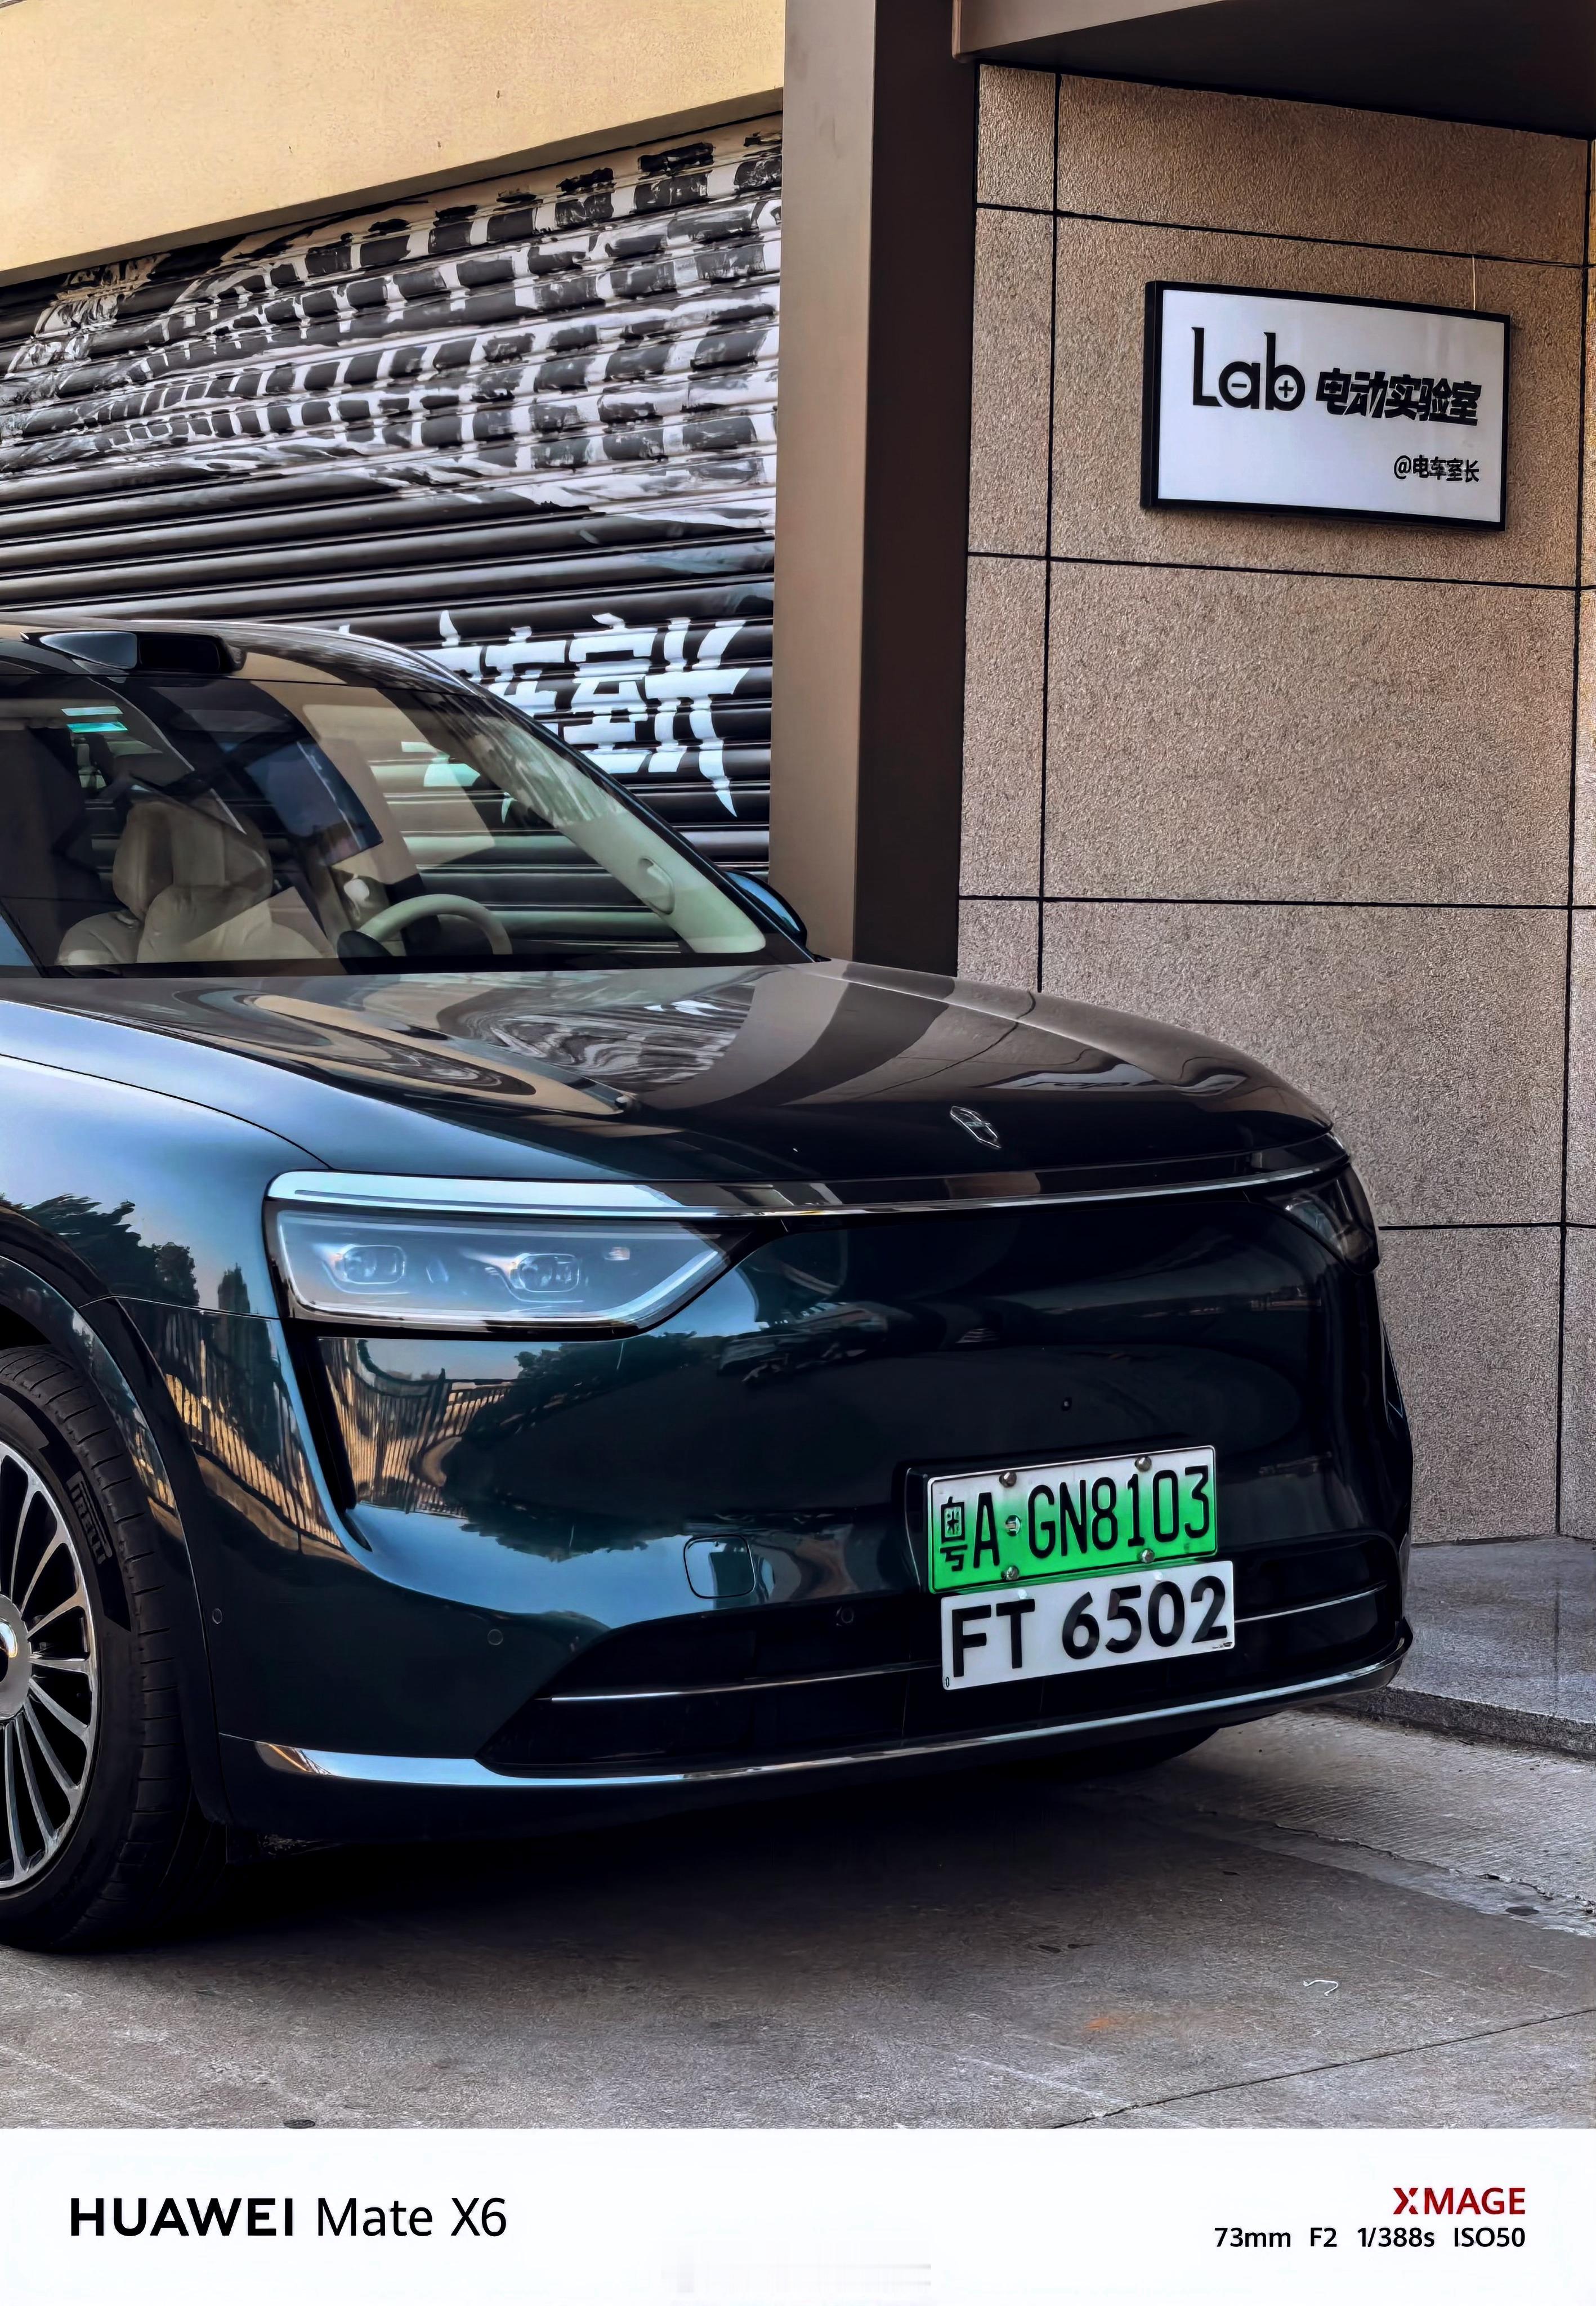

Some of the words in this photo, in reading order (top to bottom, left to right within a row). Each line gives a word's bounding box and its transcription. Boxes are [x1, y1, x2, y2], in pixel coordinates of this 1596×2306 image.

[1191, 327, 1306, 411] Lab
[1315, 367, 1482, 426] 电动实验室
[1393, 454, 1480, 483] @电车室长
[66, 1470, 113, 1565] PIRELLI
[951, 1598, 1036, 1678] FT
[1062, 1575, 1228, 1660] 6502
